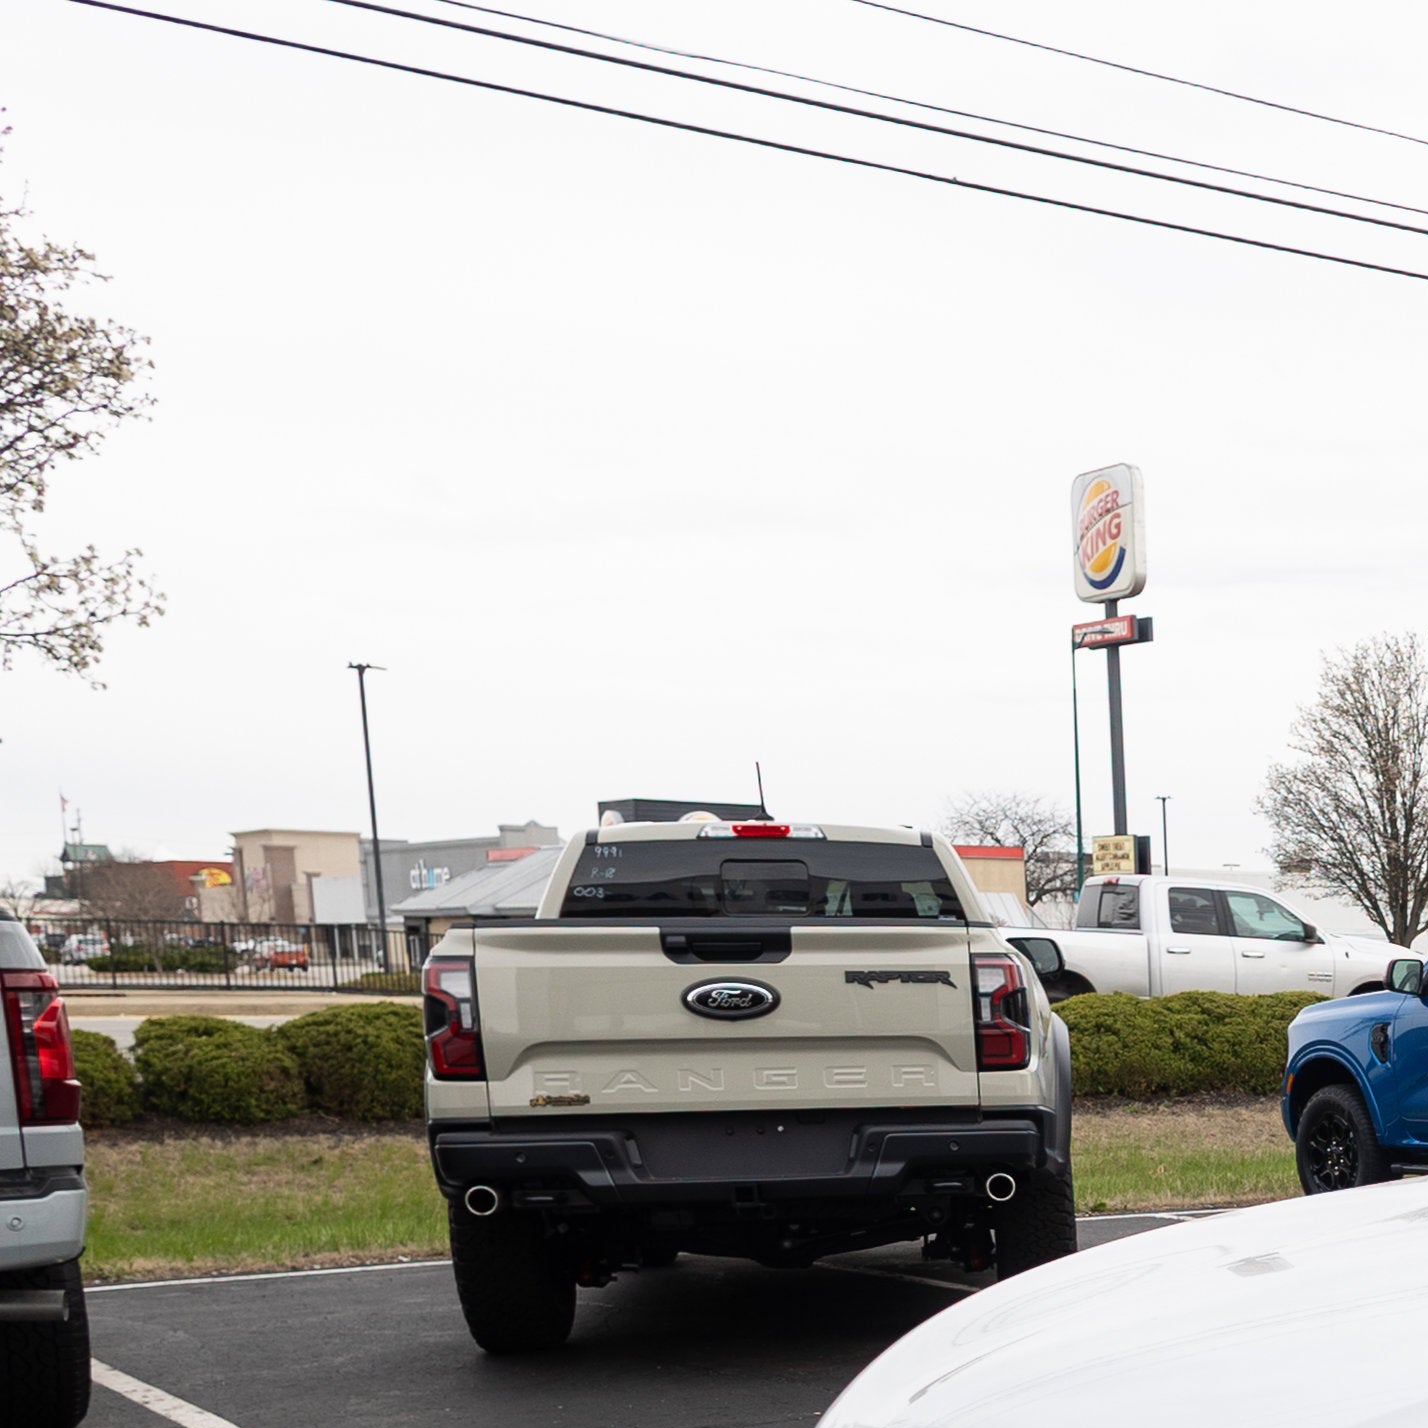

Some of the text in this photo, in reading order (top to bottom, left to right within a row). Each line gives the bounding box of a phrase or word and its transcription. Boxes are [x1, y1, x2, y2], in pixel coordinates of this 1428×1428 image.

[1080, 490, 1119, 540] BURGER
[1081, 512, 1121, 570] KING
[844, 970, 958, 989] RAPTOR
[707, 988, 752, 1008] Ford
[532, 1064, 936, 1094] RANGER
